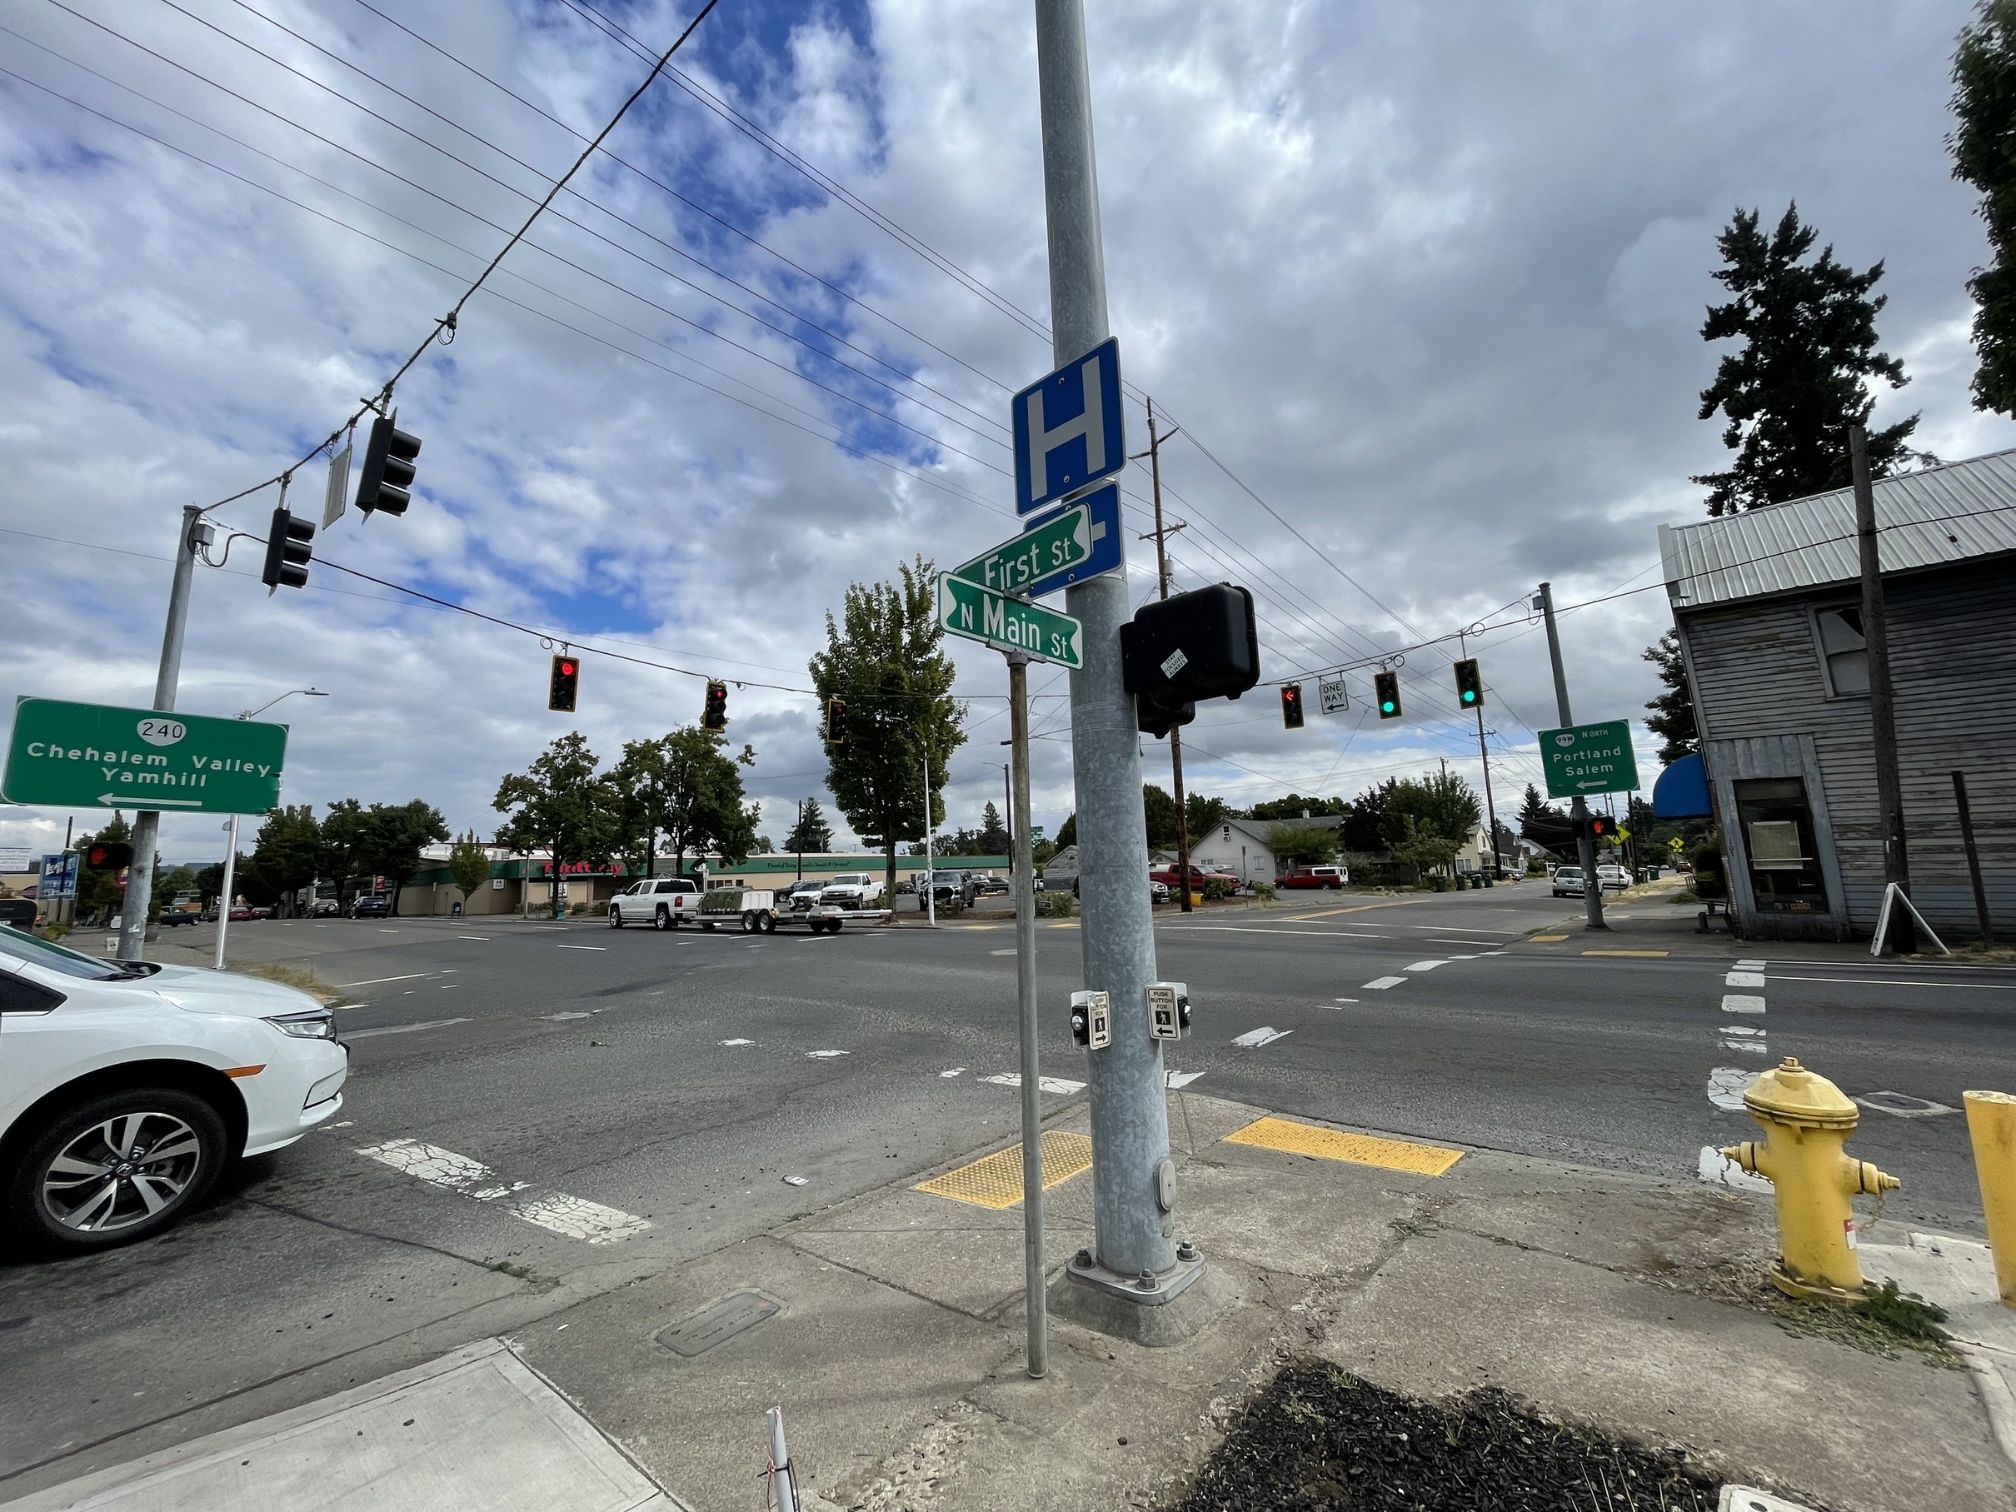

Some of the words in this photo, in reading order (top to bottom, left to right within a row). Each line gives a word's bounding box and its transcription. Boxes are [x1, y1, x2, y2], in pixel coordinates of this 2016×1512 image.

[984, 542, 1040, 591] First
[1051, 536, 1072, 567] St
[961, 602, 973, 631] N
[983, 593, 1041, 652] Main
[1051, 633, 1068, 659] St
[1323, 683, 1342, 694] ONE
[1324, 692, 1343, 703] WAY
[141, 721, 184, 739] 240
[1581, 729, 1608, 739] NORTH
[27, 742, 168, 767] Chehalem
[192, 755, 271, 778] Valley
[1553, 746, 1621, 763] Portland
[101, 767, 207, 788] Yamhill
[1565, 764, 1614, 776] Salem
